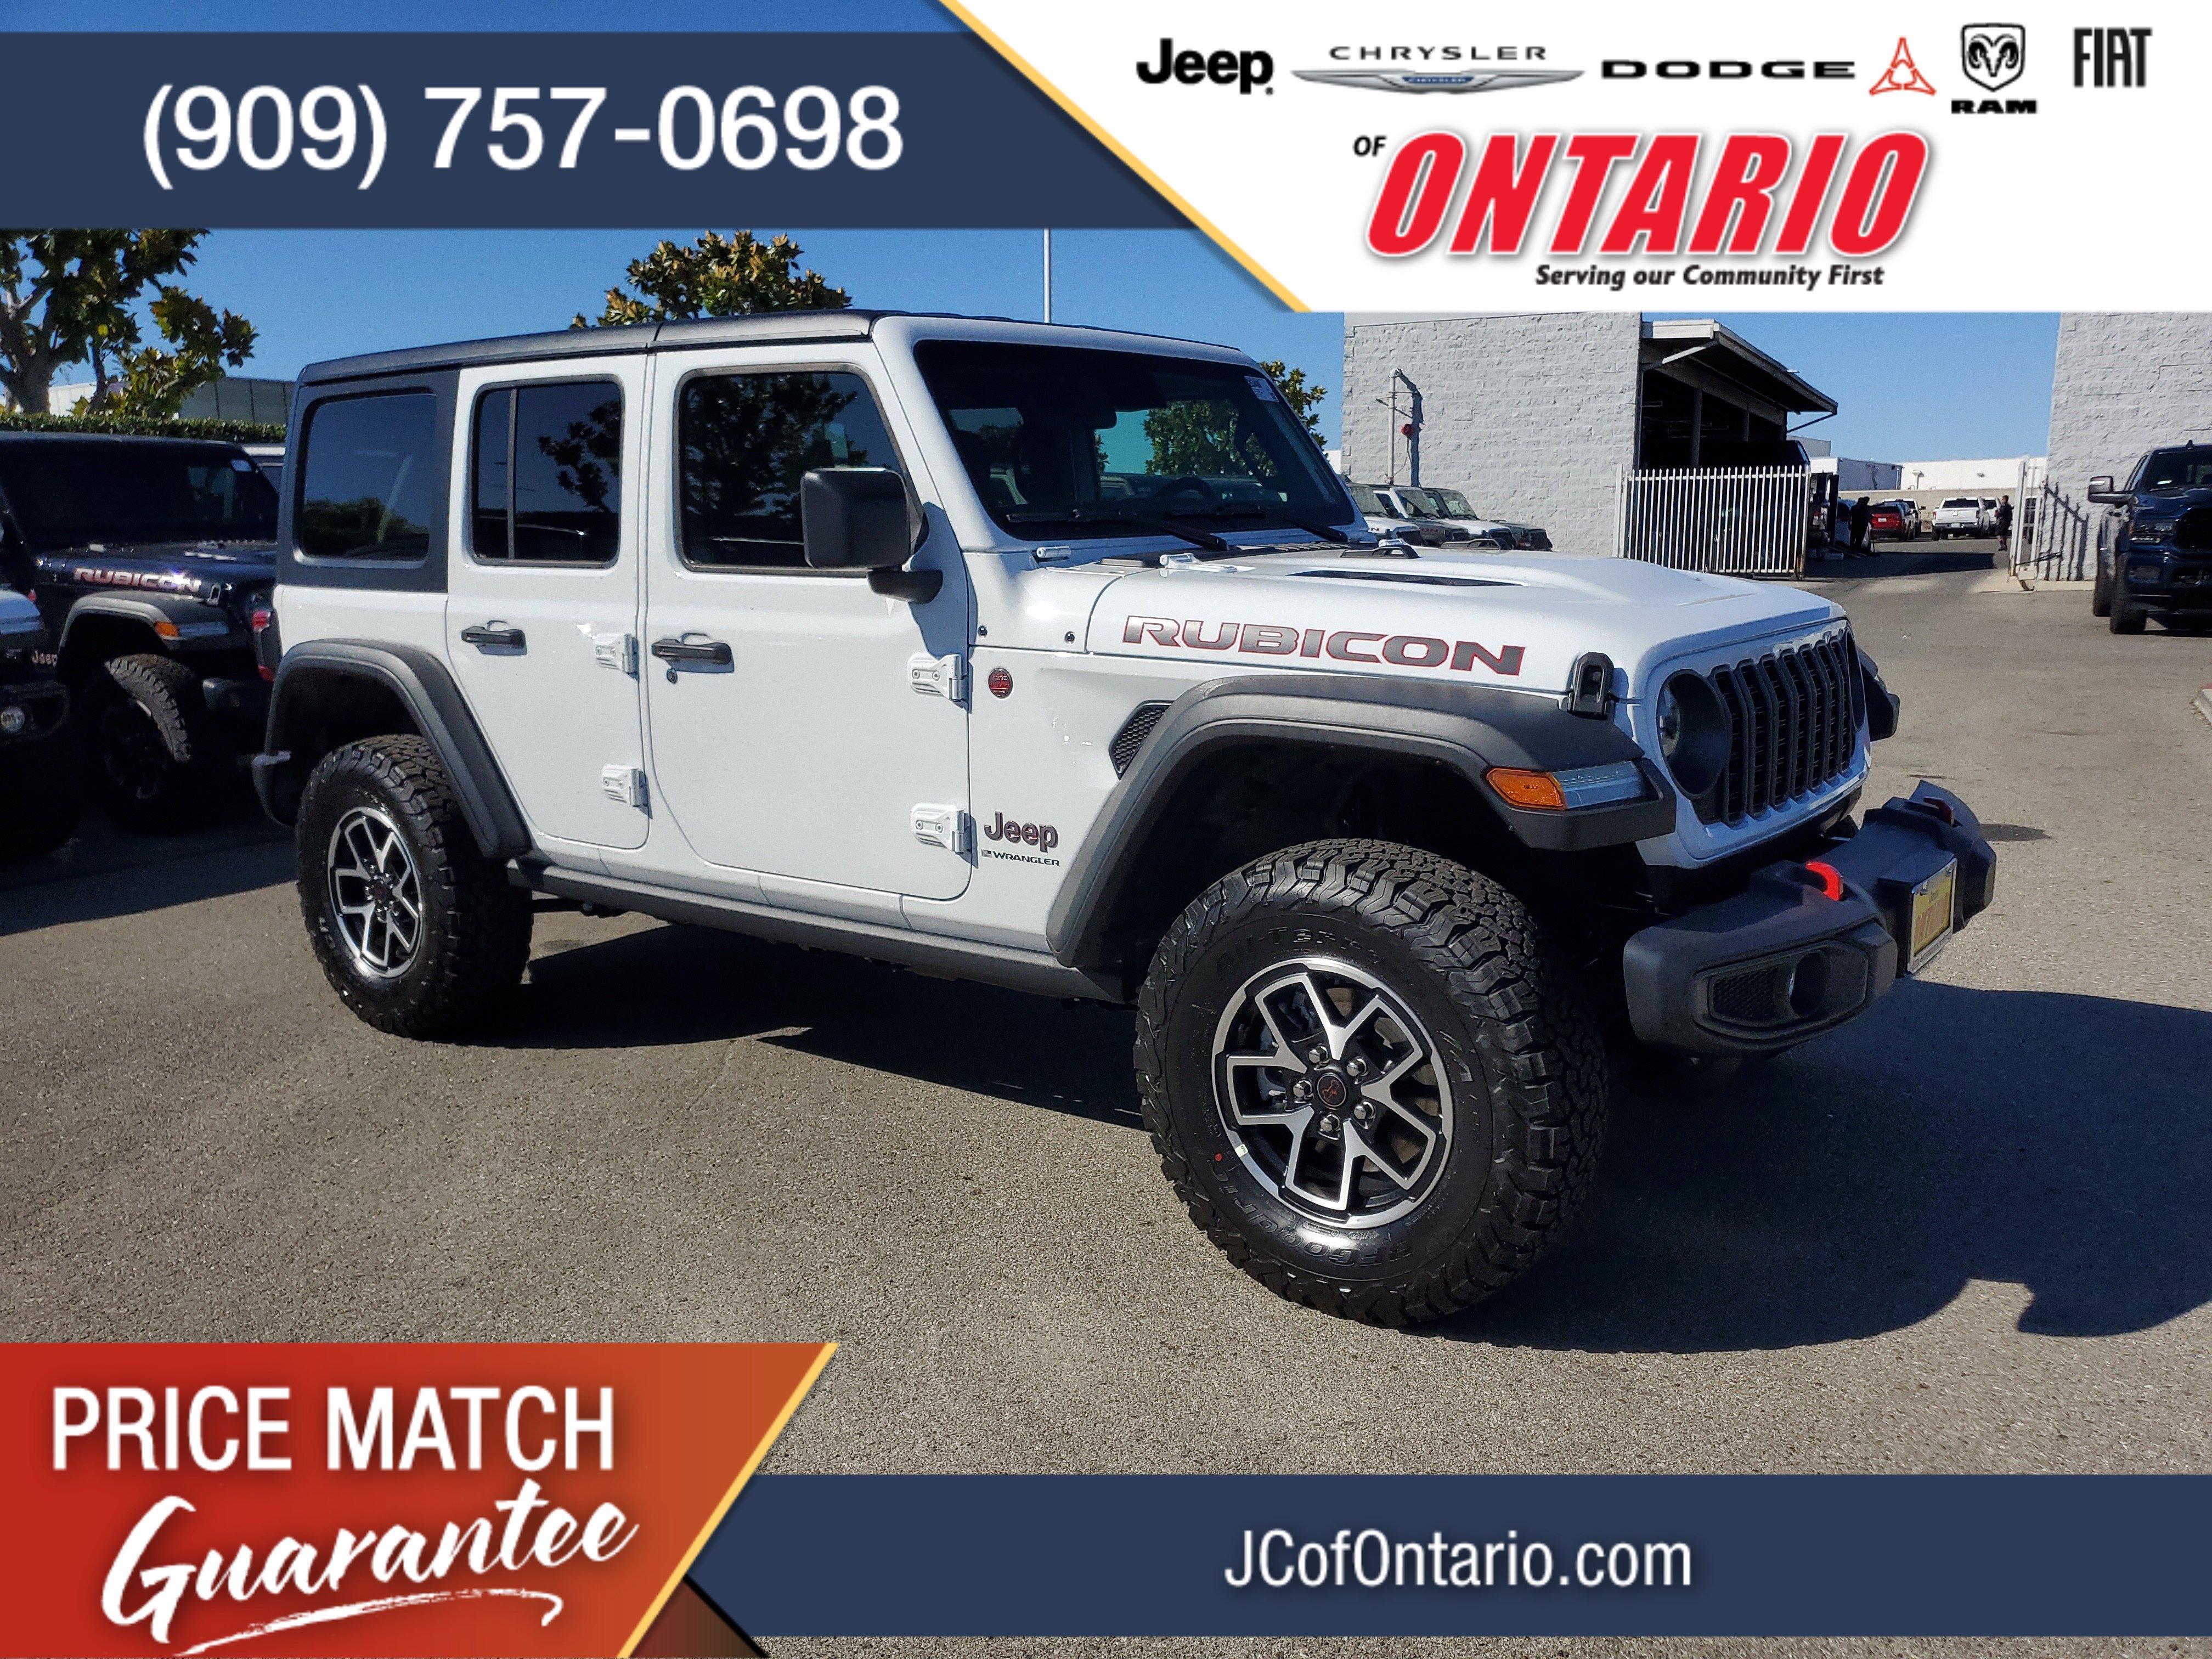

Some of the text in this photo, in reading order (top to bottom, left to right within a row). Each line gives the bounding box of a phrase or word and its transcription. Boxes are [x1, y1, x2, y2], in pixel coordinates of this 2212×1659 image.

[74, 567, 202, 592] RUBICON
[31, 648, 58, 668] Jeep
[1122, 615, 1525, 676] RUBICON
[984, 811, 1059, 853] Jeep
[992, 850, 1060, 867] WRANGLER
